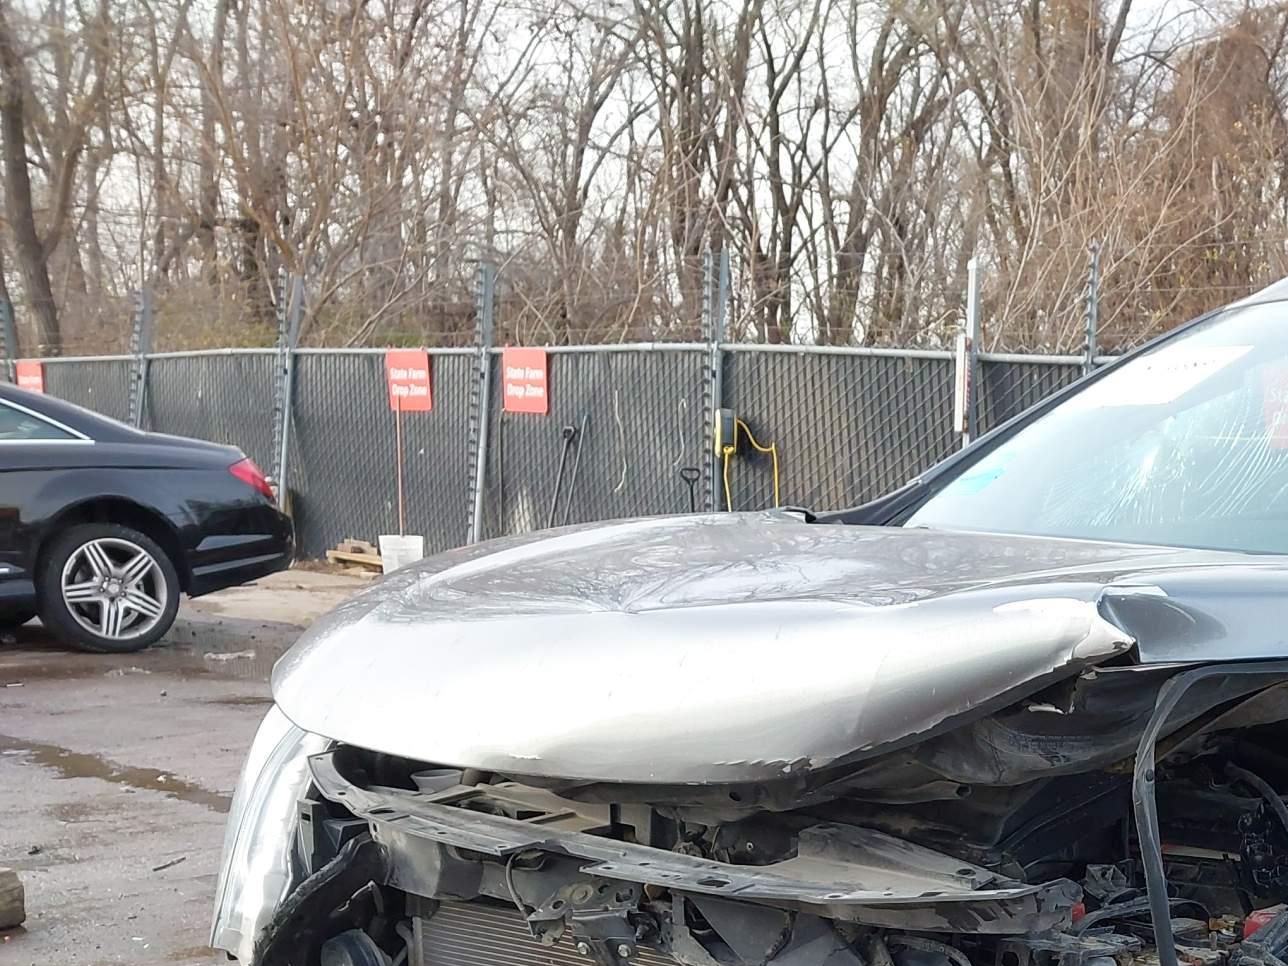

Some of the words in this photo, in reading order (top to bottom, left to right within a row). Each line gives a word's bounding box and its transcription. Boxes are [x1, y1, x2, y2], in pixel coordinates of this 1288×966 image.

[390, 367, 408, 380] State
[408, 367, 426, 380] Farm
[506, 366, 524, 380] State
[525, 366, 544, 380] Farm
[391, 383, 409, 398] Drop
[409, 383, 427, 397] Zone
[507, 383, 525, 399] Drop
[525, 383, 544, 397] Zone
